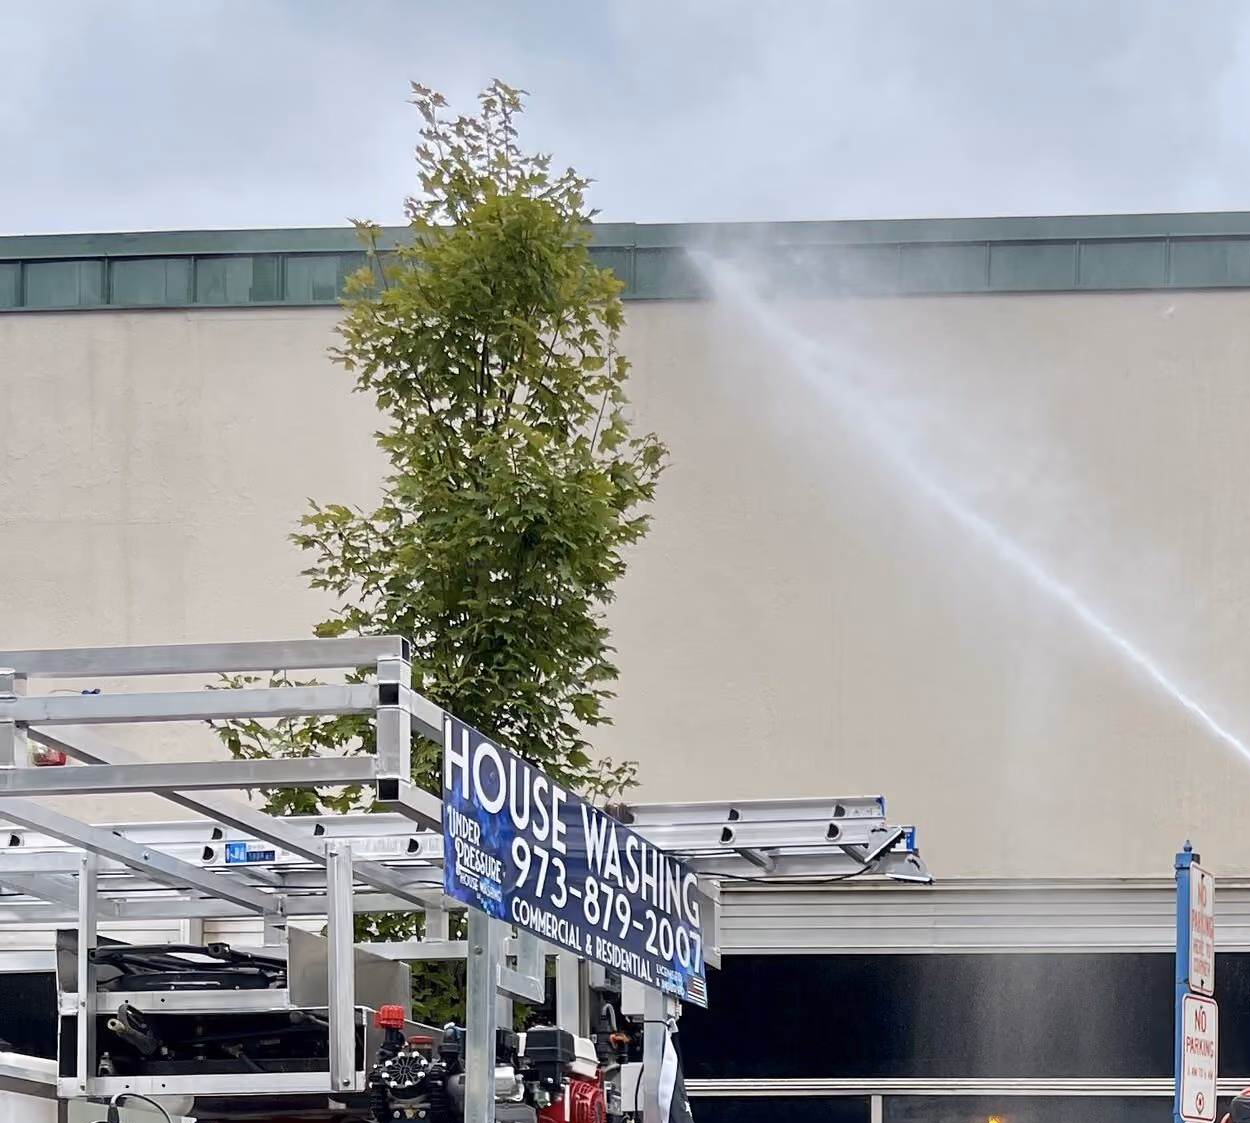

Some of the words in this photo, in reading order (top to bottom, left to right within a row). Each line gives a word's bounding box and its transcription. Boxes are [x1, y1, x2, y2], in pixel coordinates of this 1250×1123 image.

[445, 718, 567, 855] HOUSE
[581, 803, 699, 928] WASHING
[447, 805, 480, 846] UNDER
[455, 837, 501, 884] PRESSURE
[512, 836, 700, 974] 973-879-2007
[512, 896, 582, 952] COMMERCIAL
[585, 934, 593, 956] &
[596, 936, 652, 983] RESIDENTIAL
[1195, 1009, 1207, 1032] NO
[1186, 1037, 1213, 1059] PARKING
